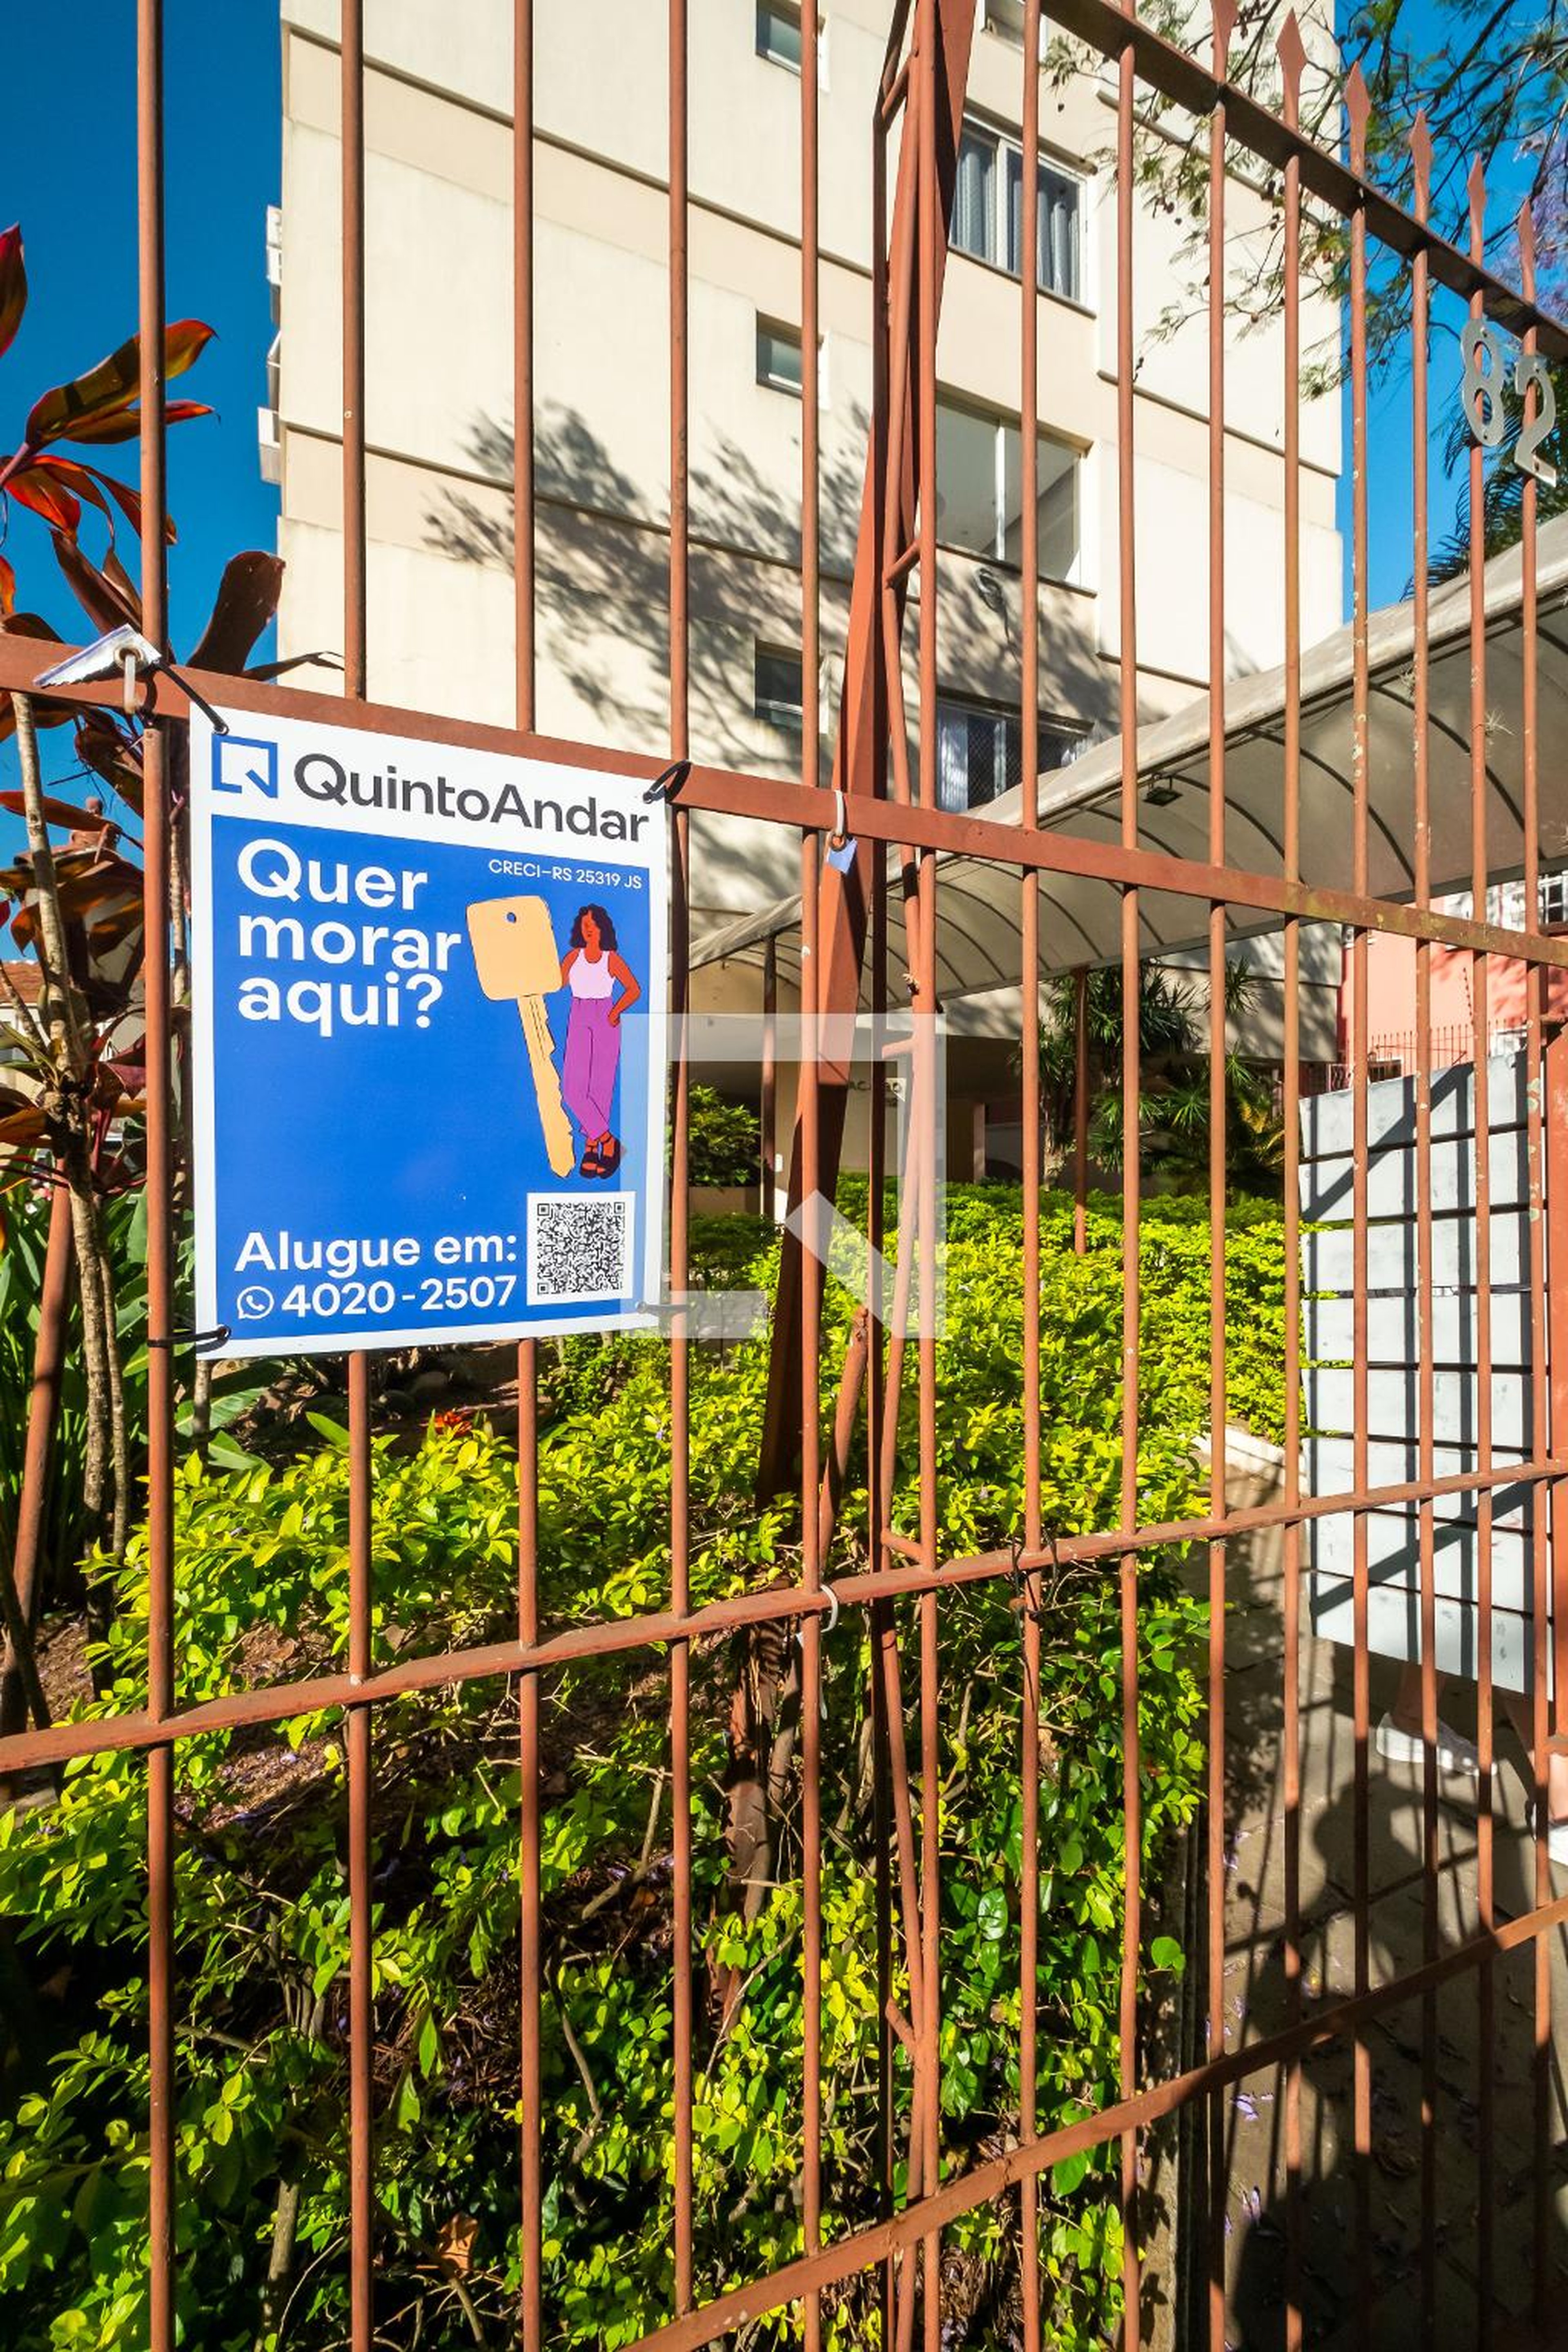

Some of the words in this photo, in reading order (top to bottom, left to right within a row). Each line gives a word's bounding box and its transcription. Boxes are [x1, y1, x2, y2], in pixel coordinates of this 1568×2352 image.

[1461, 318, 1556, 488] 82
[293, 753, 650, 843] QuintoAndar
[237, 838, 428, 911] Quer
[488, 859, 572, 882] CRECI-RS
[575, 869, 621, 887] 25319
[624, 875, 642, 890] JS
[238, 915, 462, 972] morar
[238, 970, 444, 1038] aqui?
[234, 1230, 421, 1279] Alugue
[434, 1234, 517, 1265] em:
[281, 1274, 517, 1318] 4020-2507
